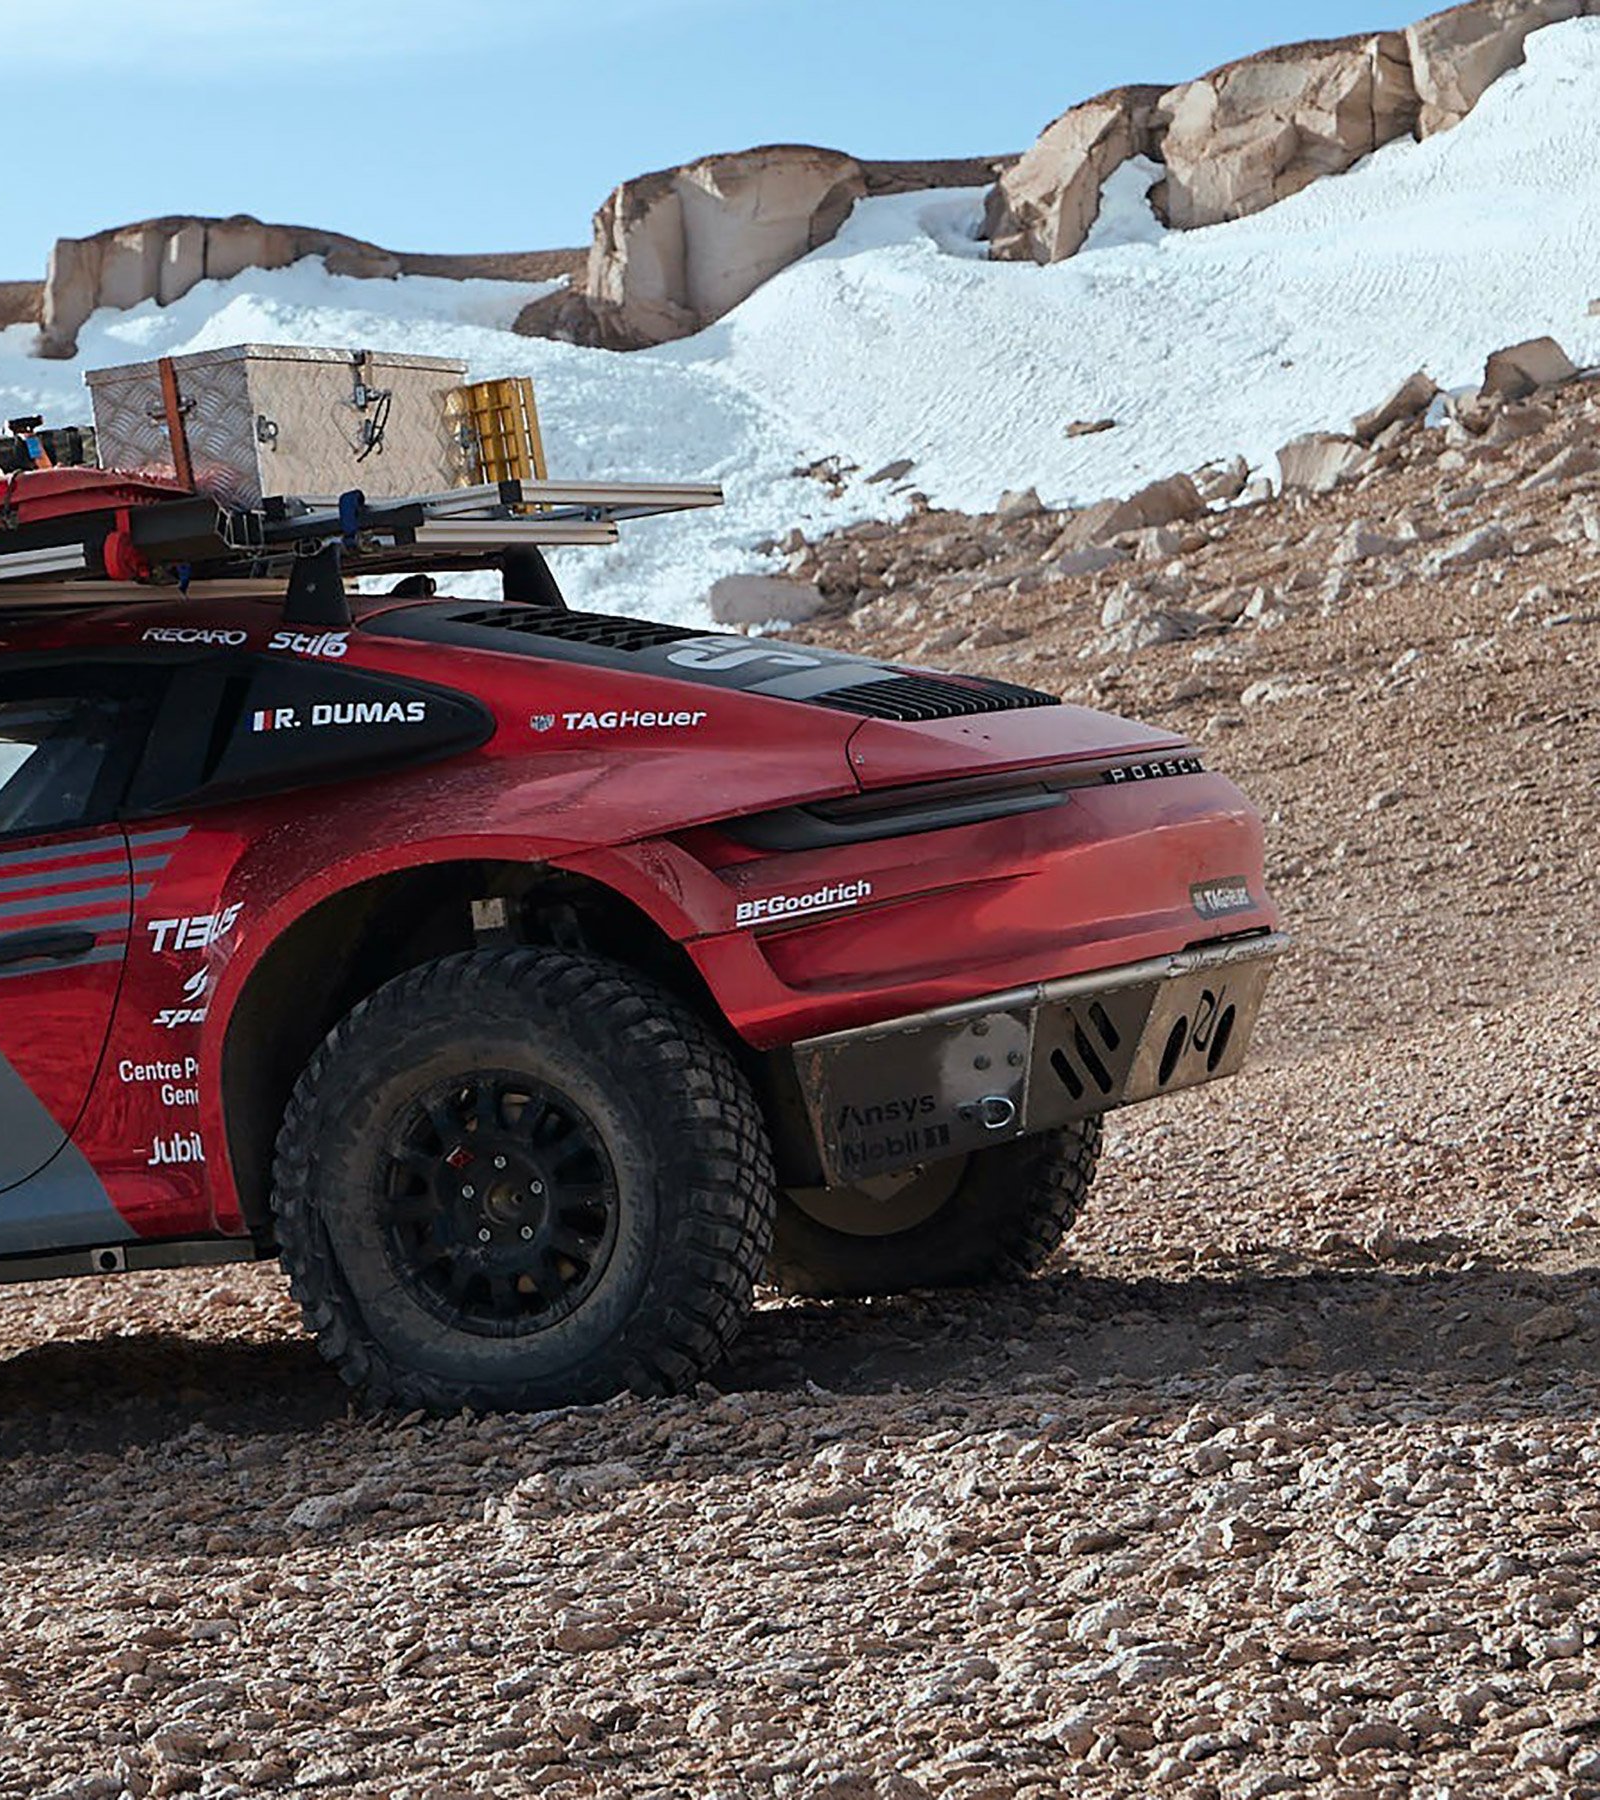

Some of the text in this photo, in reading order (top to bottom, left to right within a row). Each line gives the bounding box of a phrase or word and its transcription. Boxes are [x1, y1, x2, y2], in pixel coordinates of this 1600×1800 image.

[142, 628, 248, 646] RECARO
[274, 701, 426, 730] R. DUMAS
[736, 880, 872, 922] BFGoodrich
[118, 1060, 182, 1082] Centre
[837, 1094, 936, 1132] Ansys
